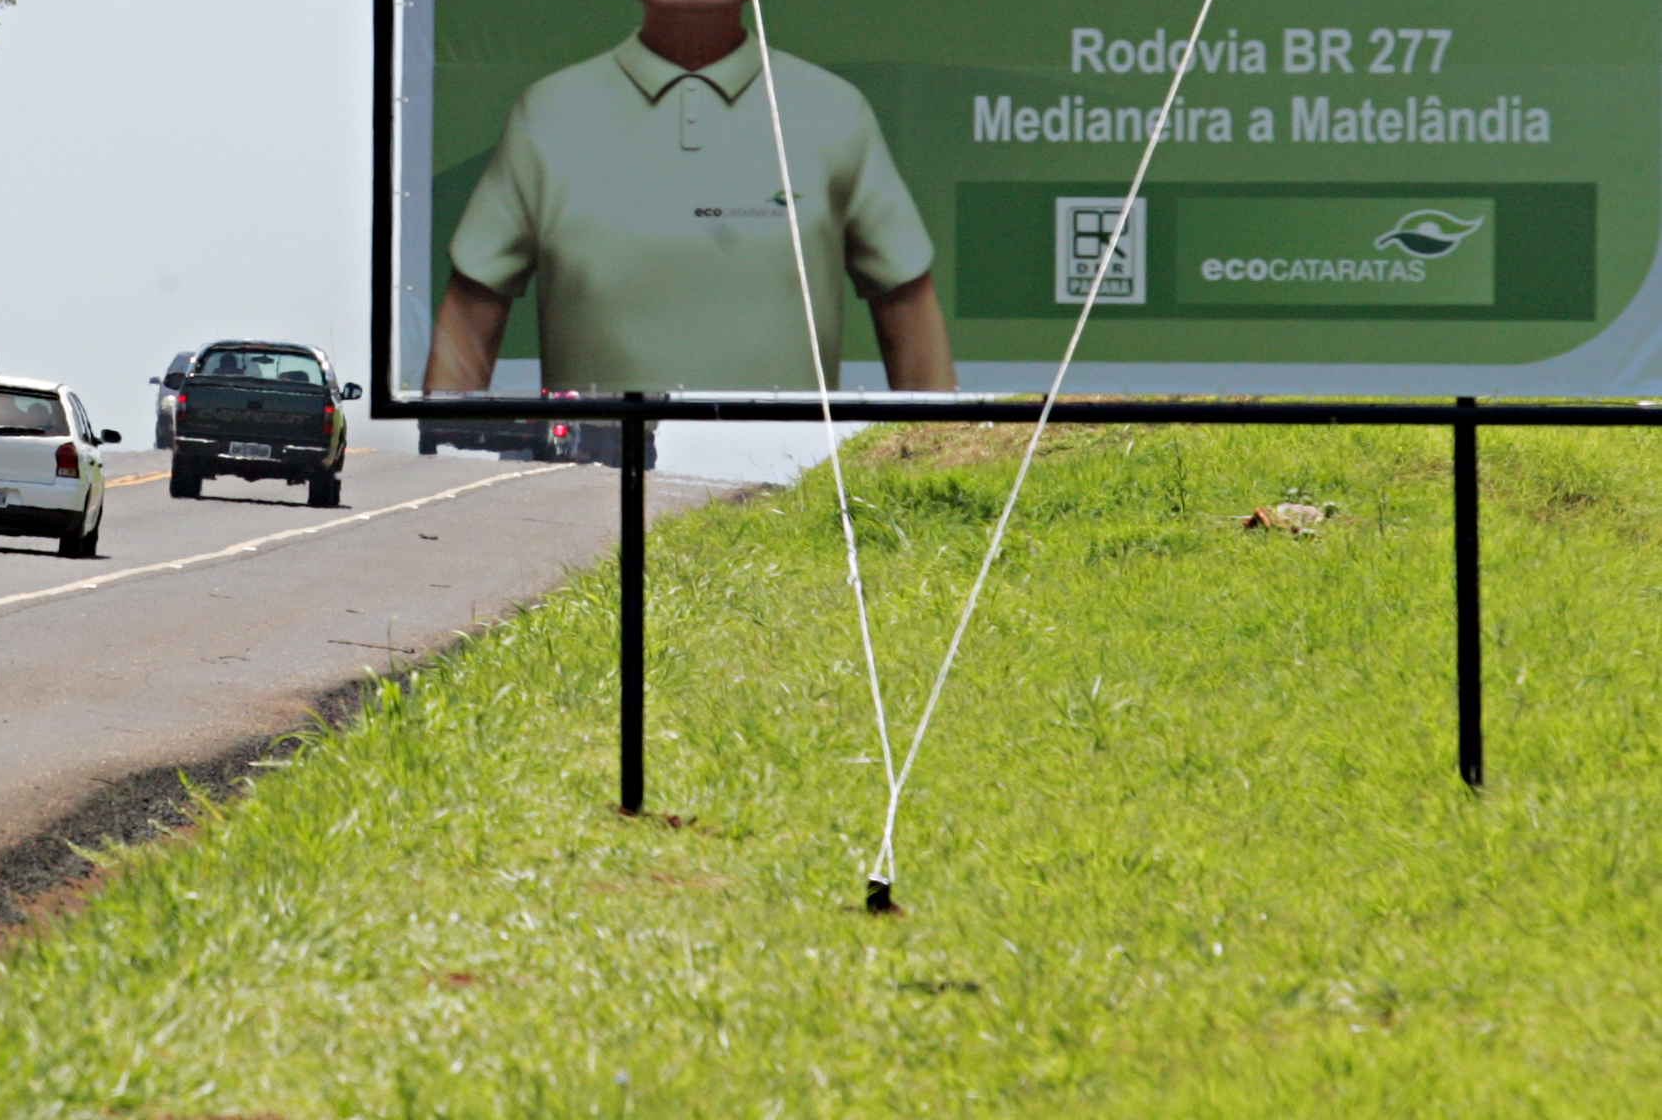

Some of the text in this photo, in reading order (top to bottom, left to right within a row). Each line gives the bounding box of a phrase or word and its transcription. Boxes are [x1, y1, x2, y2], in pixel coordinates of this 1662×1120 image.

[1070, 27, 1454, 75] Rodovia BR 277
[973, 94, 1552, 144] Medianeira a Matelândia
